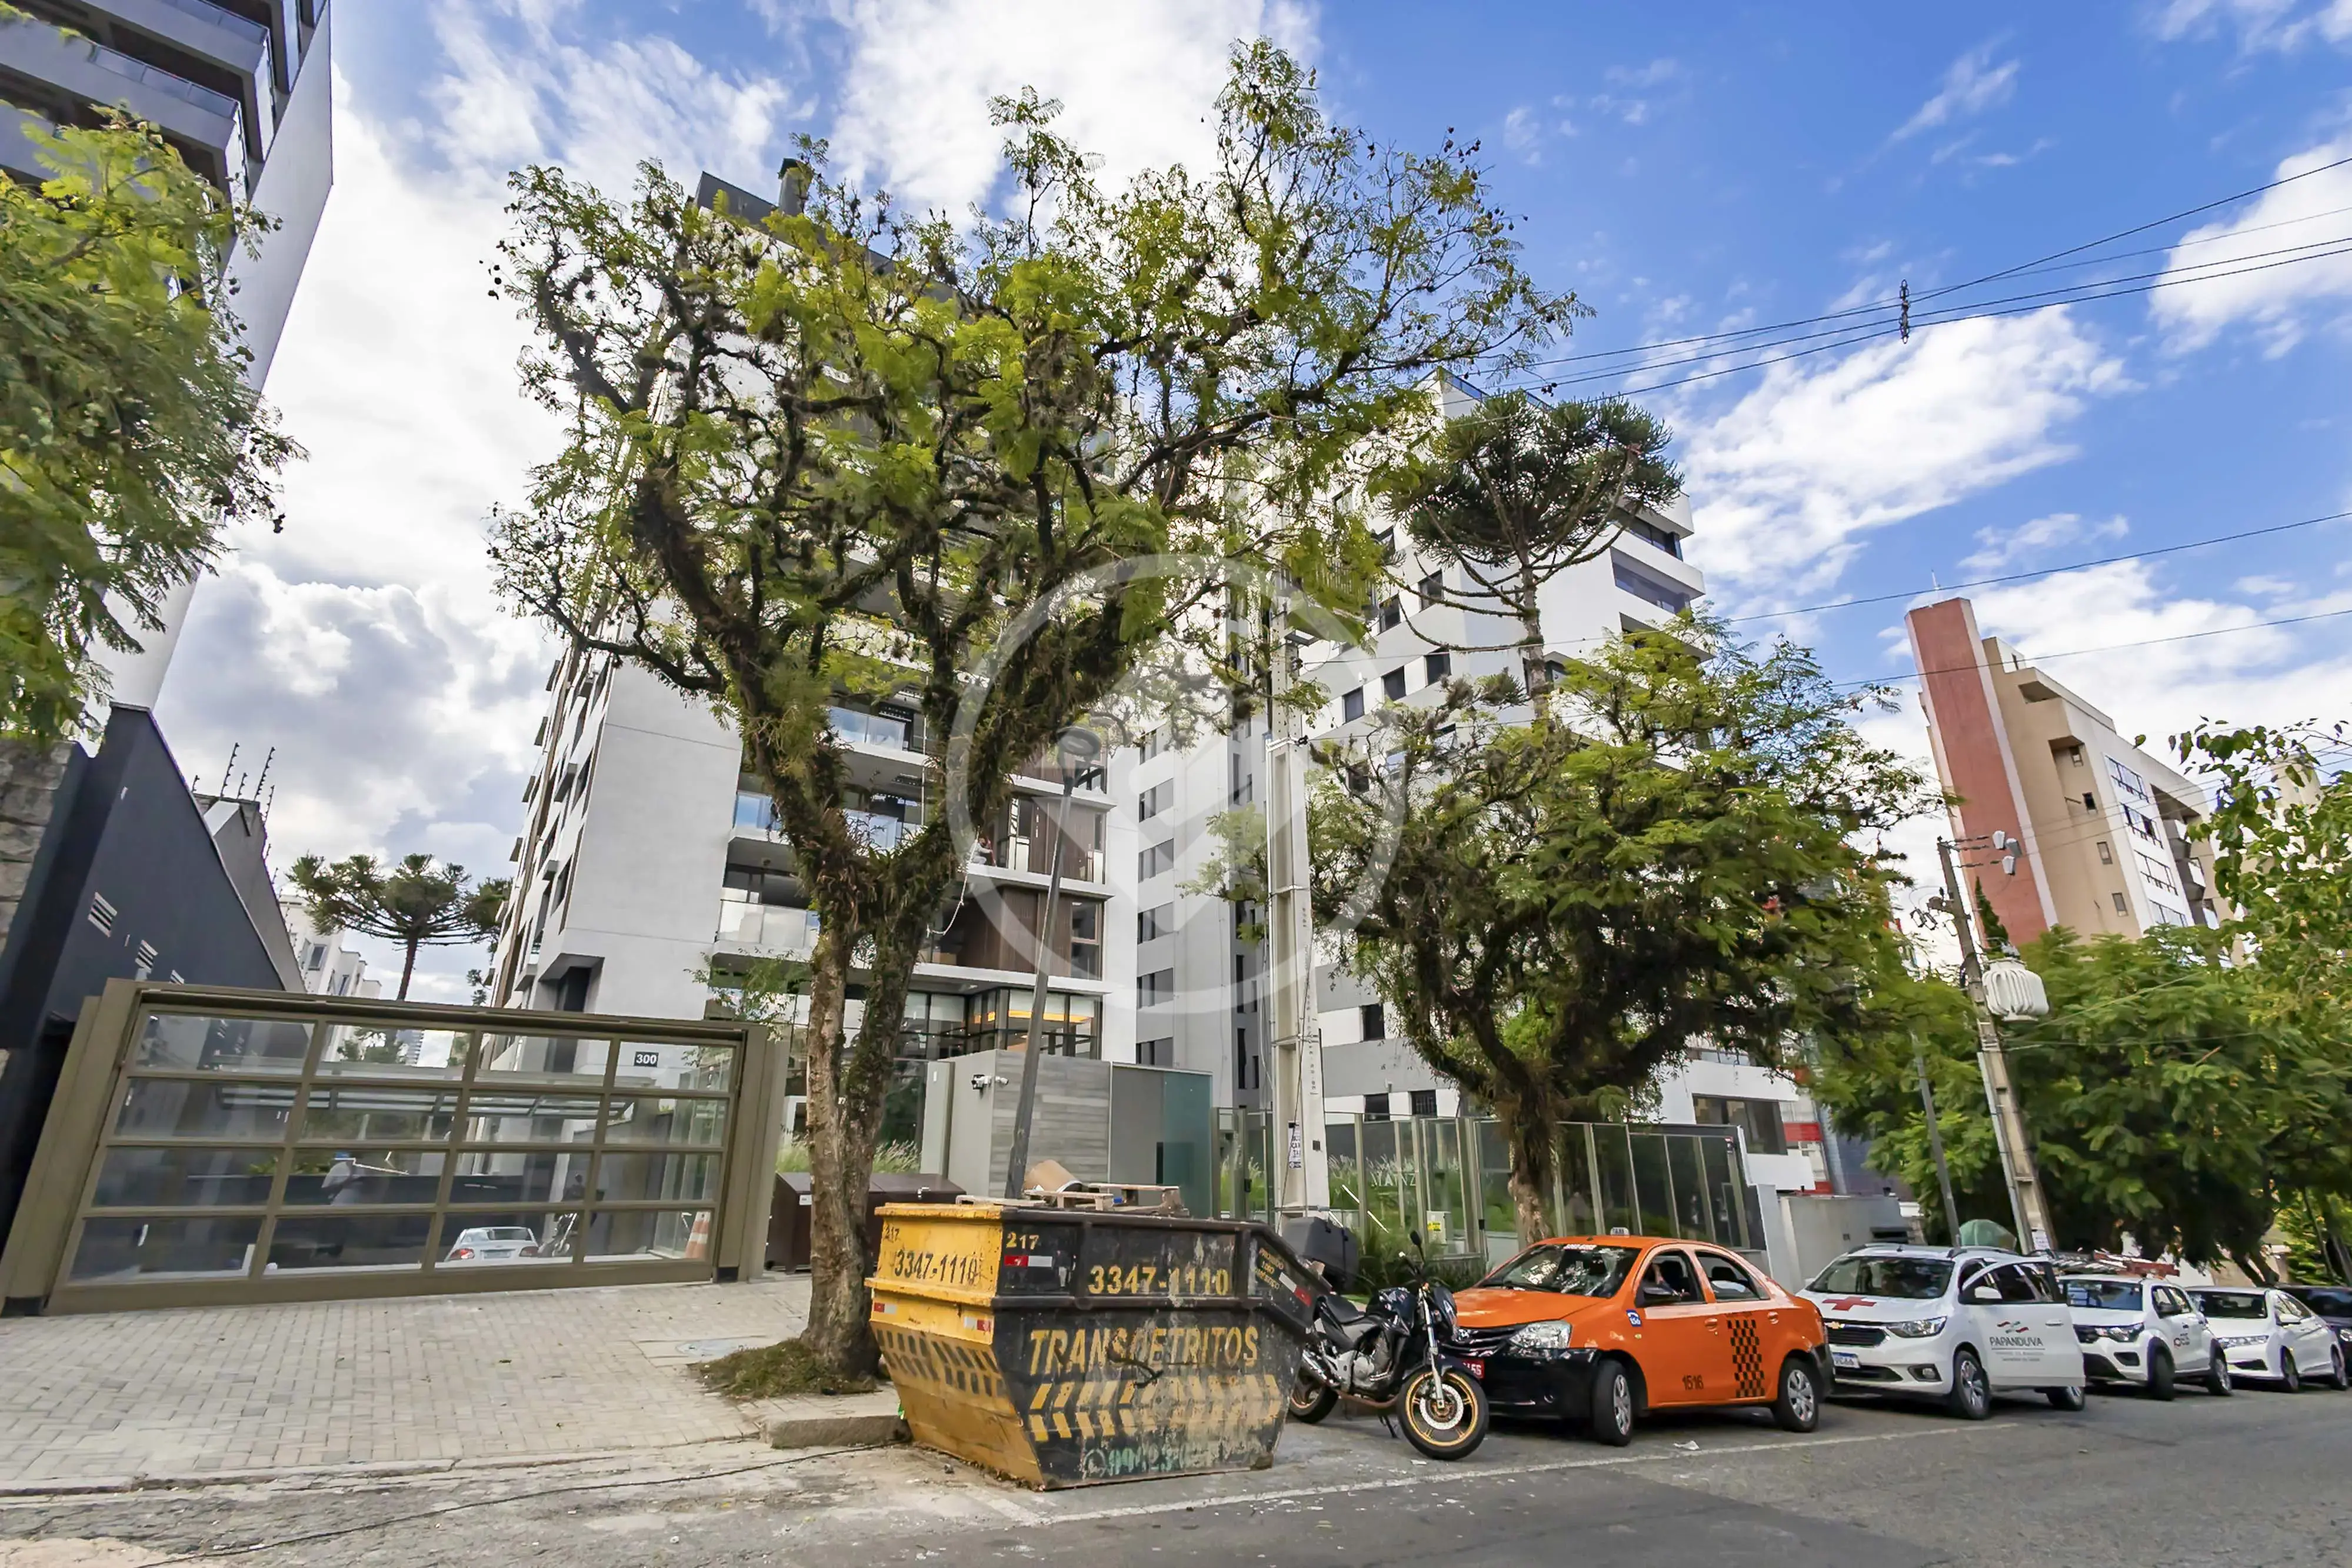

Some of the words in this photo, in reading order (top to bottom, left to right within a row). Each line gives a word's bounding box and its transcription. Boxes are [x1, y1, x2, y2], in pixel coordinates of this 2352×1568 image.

[636, 1054, 657, 1065] 300
[1007, 1231, 1039, 1250] 217
[895, 1249, 977, 1285] 3347-1110
[1088, 1265, 1228, 1295] 3347-1110
[1990, 1336, 2044, 1346] PAPANDUVA
